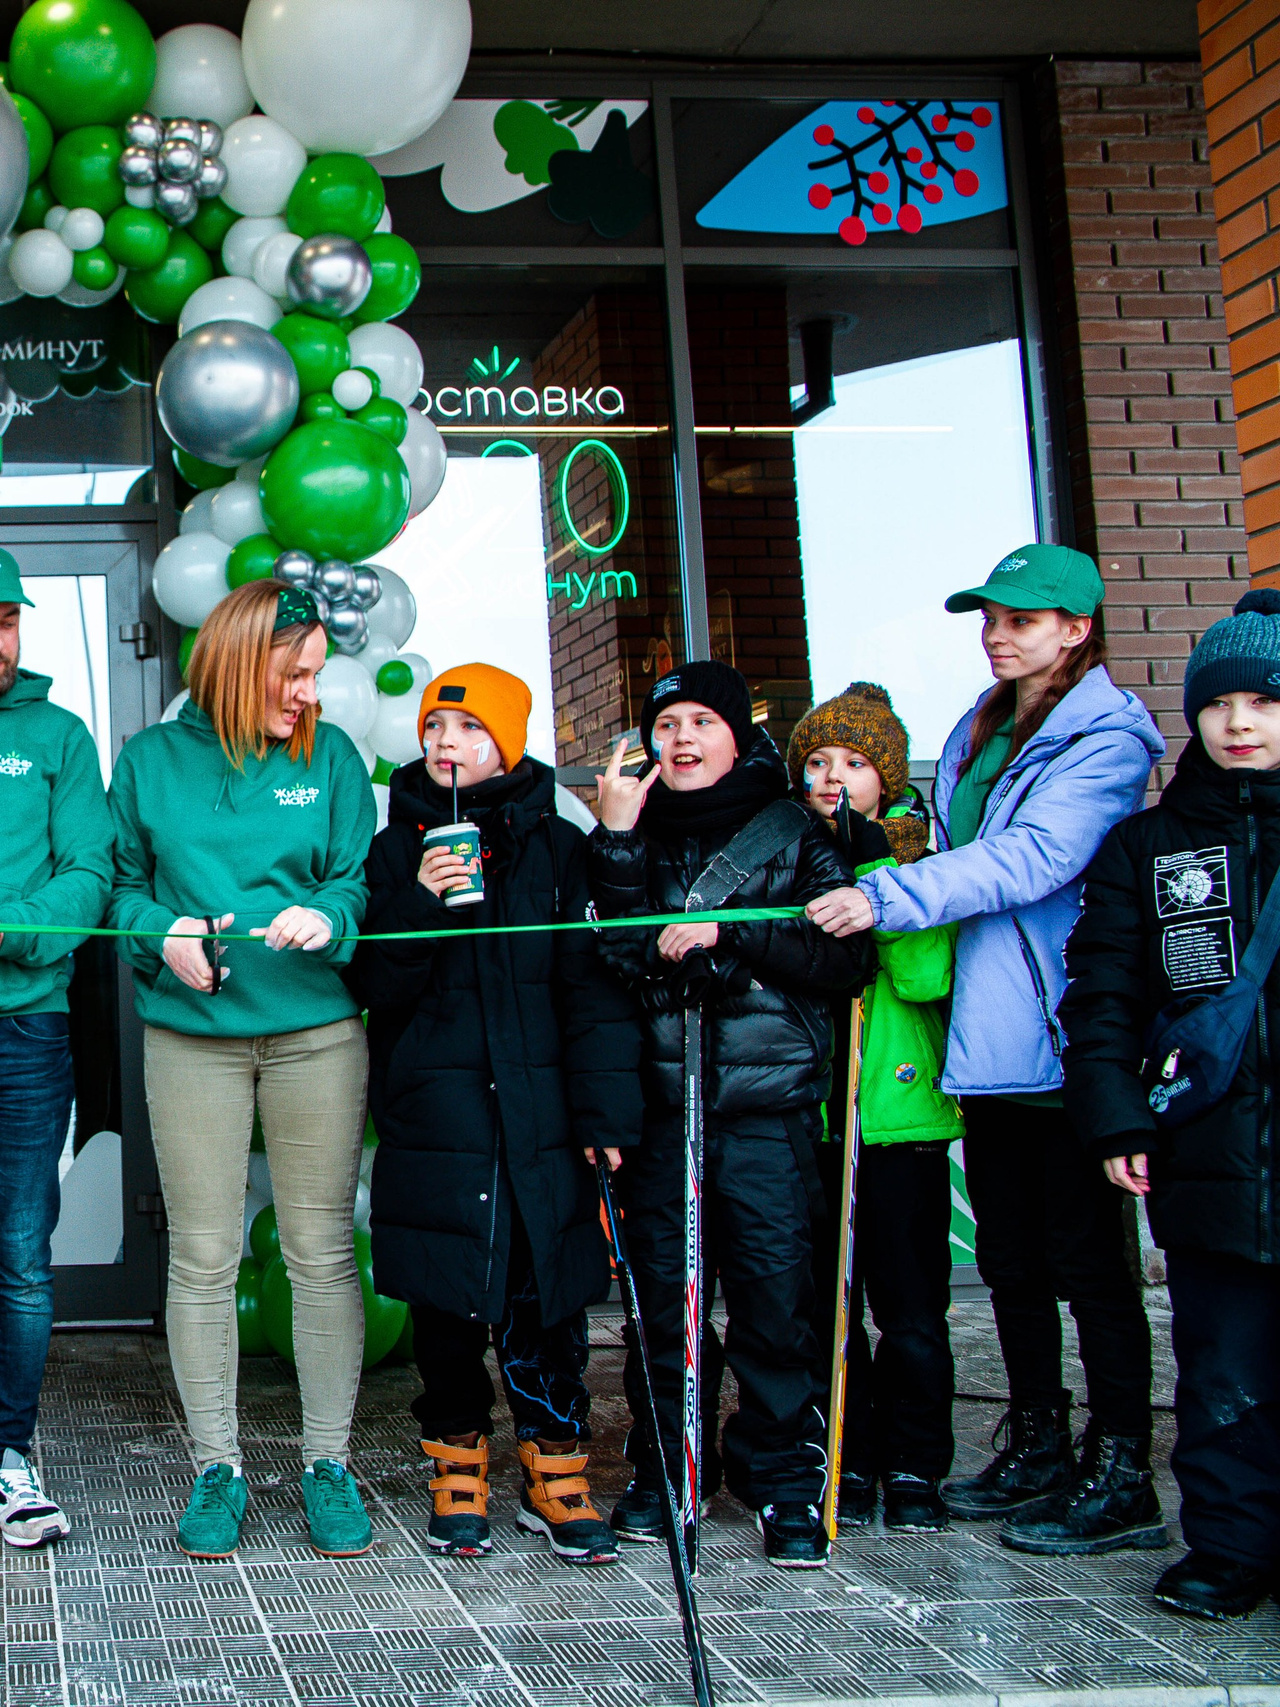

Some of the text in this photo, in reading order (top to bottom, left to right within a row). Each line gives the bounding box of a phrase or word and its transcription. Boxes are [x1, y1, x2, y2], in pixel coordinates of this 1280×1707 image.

[1, 337, 105, 373] минут
[418, 386, 625, 416] оставка
[546, 570, 638, 609] нут
[688, 1196, 696, 1271] YOUTH
[687, 1376, 695, 1430] RGX
